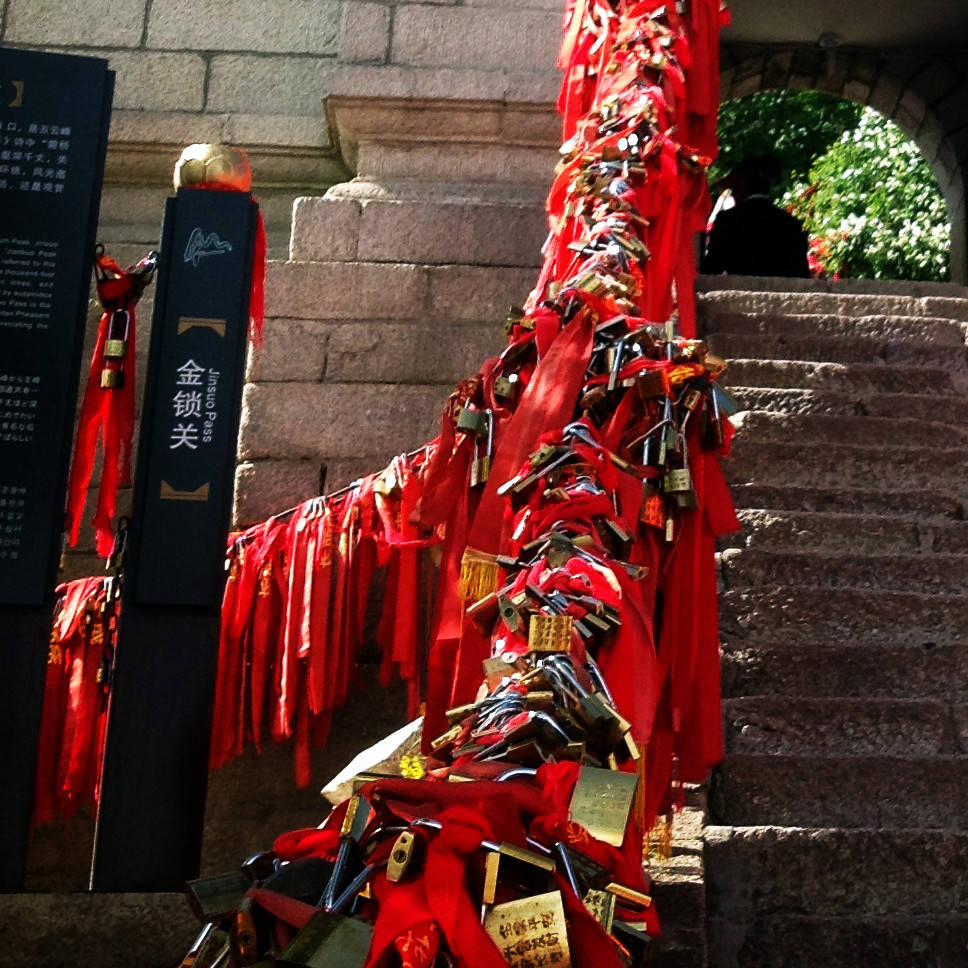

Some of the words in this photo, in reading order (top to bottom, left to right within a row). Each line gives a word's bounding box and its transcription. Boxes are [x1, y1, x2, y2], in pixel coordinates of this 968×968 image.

[169, 359, 206, 450] 金锁关
[205, 368, 220, 409] Jinsuo
[202, 412, 217, 443] Pass
